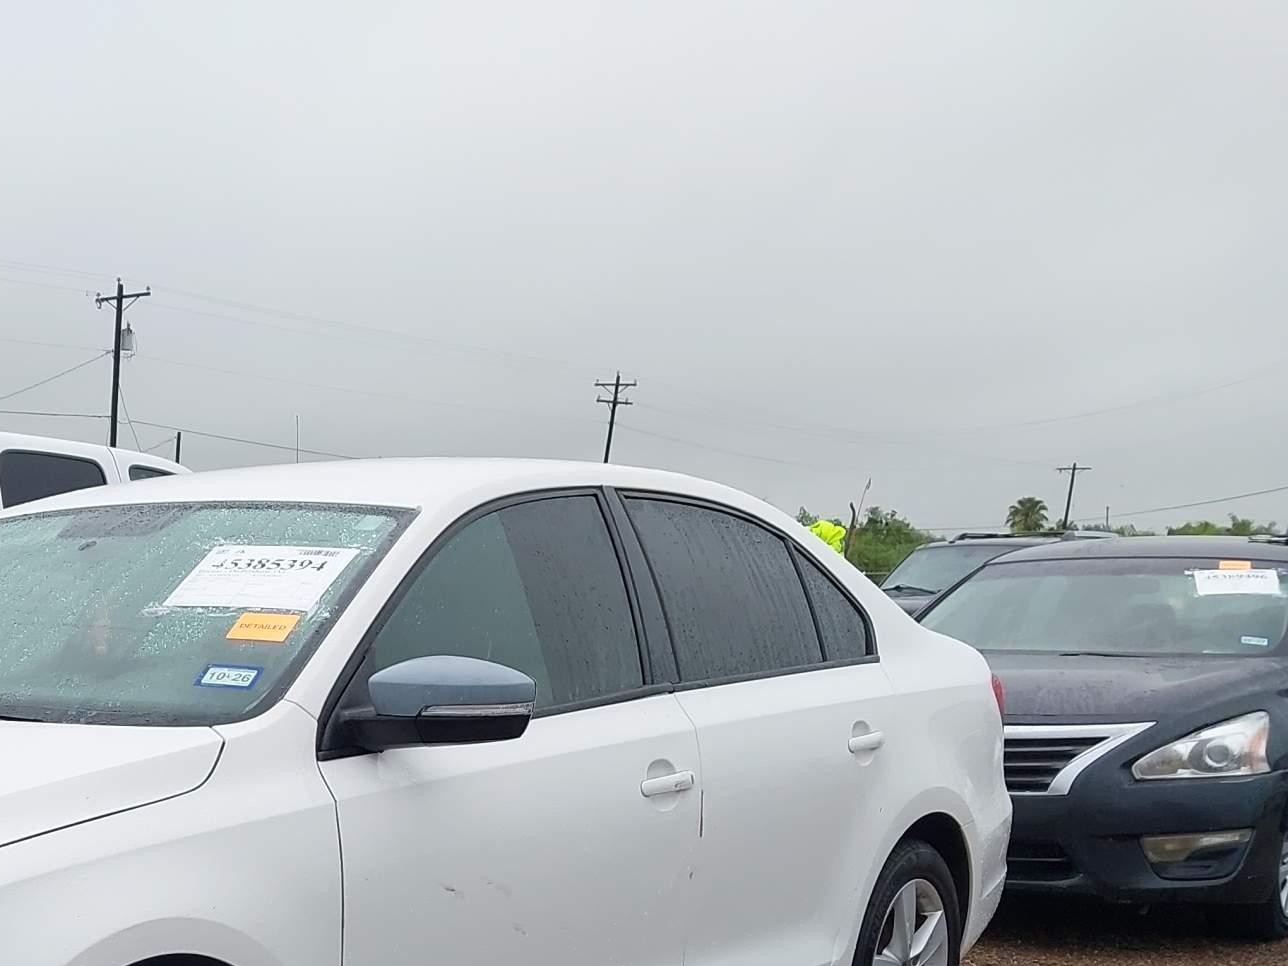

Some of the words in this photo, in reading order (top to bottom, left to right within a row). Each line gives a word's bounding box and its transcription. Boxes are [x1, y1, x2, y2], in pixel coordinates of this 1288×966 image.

[211, 559, 328, 571] 45385394
[239, 623, 287, 631] DETAILED
[208, 671, 226, 681] 10
[231, 672, 253, 683] 26
